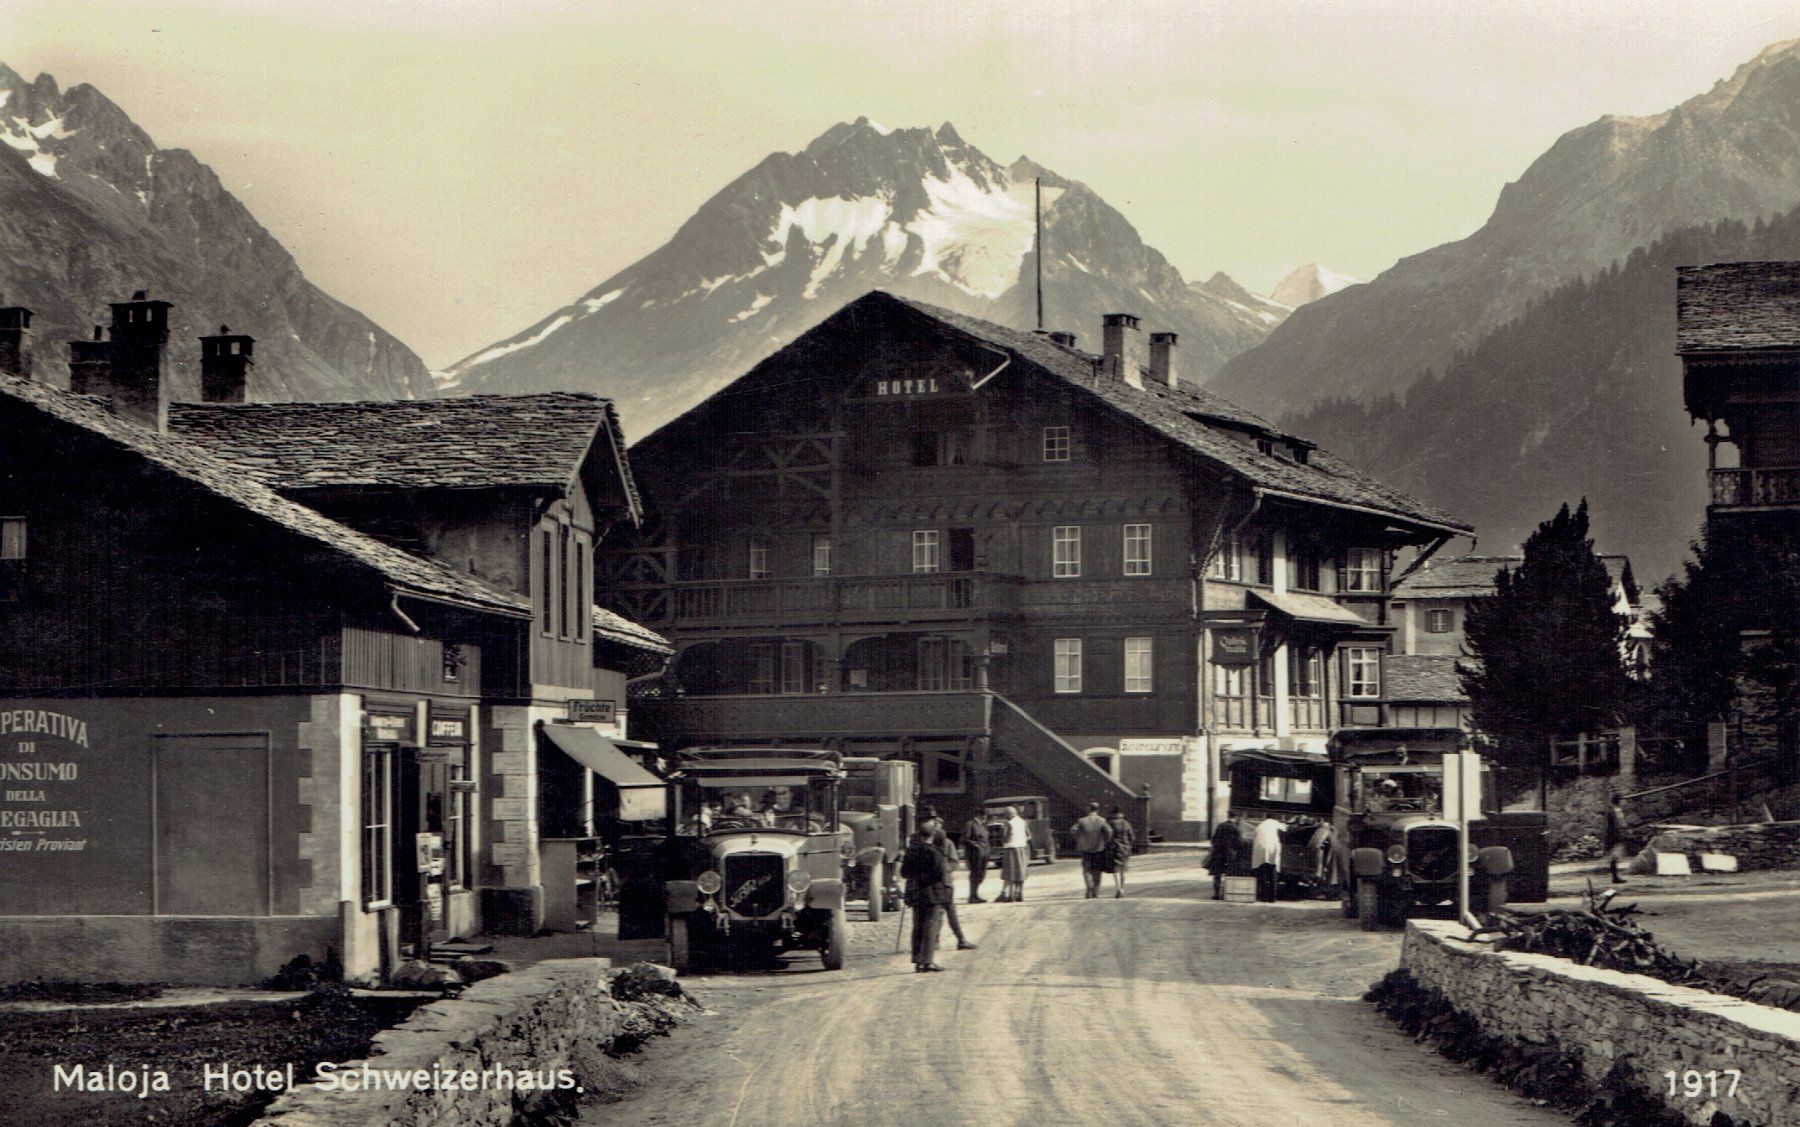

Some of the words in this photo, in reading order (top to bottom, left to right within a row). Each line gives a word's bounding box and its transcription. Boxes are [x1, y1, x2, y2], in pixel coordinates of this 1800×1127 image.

[877, 378, 938, 395] HOTEL
[0, 709, 89, 749] PERATIVA
[18, 741, 36, 753] DI
[6, 790, 46, 802] DELLA
[0, 810, 81, 827] EGAGLIA
[0, 837, 32, 851] isten
[36, 837, 88, 851] Proviant
